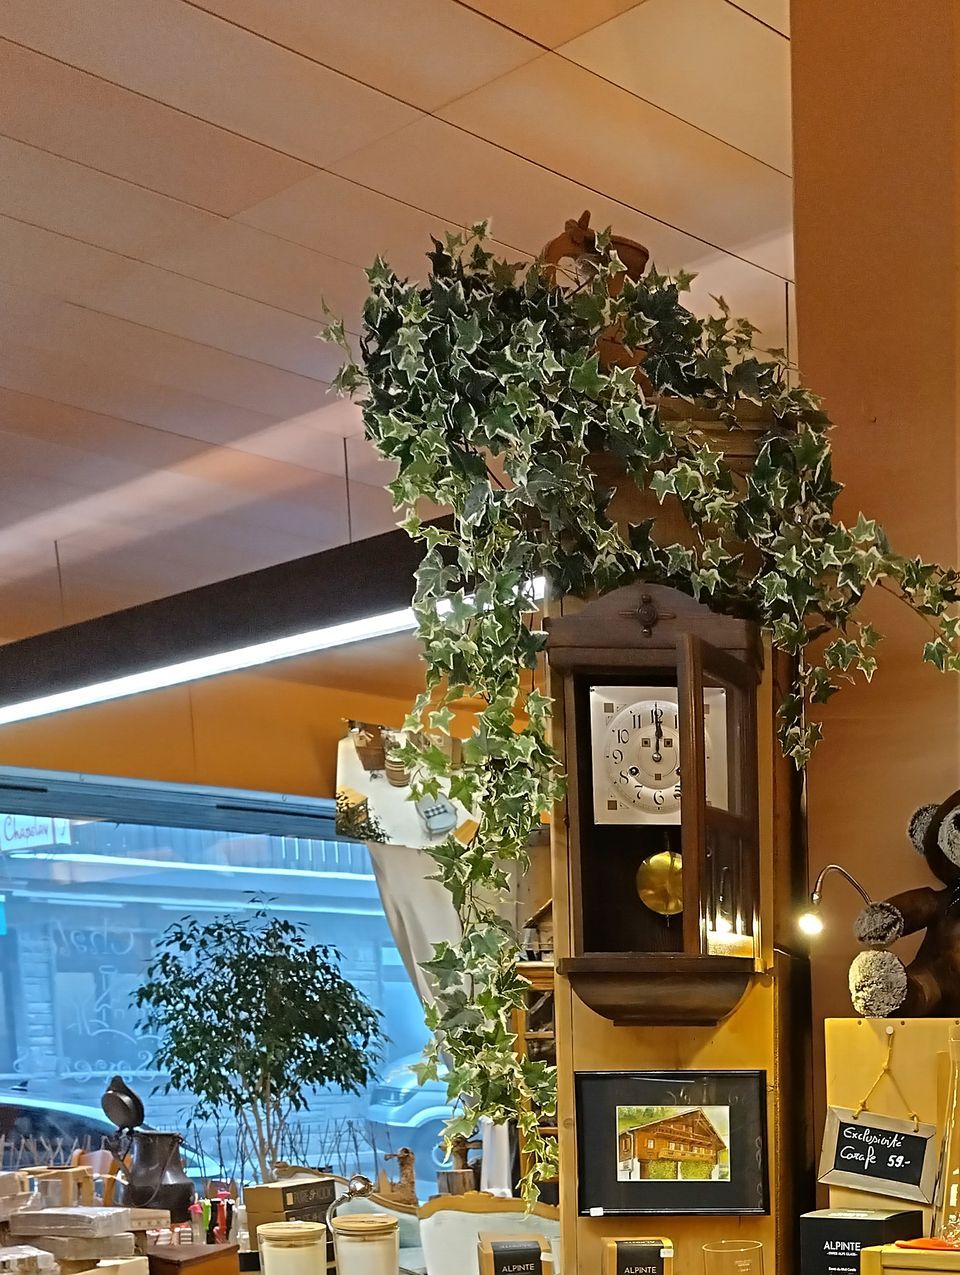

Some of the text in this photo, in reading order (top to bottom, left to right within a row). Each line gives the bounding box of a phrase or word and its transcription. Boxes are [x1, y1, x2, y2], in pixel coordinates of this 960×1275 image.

[632, 714, 642, 729] 11
[617, 729, 630, 744] 10
[612, 749, 624, 764] 9
[619, 770, 629, 785] 8
[634, 785, 643, 800] 7
[653, 790, 665, 806] 6
[843, 1126, 905, 1148] Exclusivité
[823, 1240, 861, 1251] ALPINTE
[501, 1263, 536, 1273] ALPINTE
[624, 1266, 657, 1275] ALPINTE
